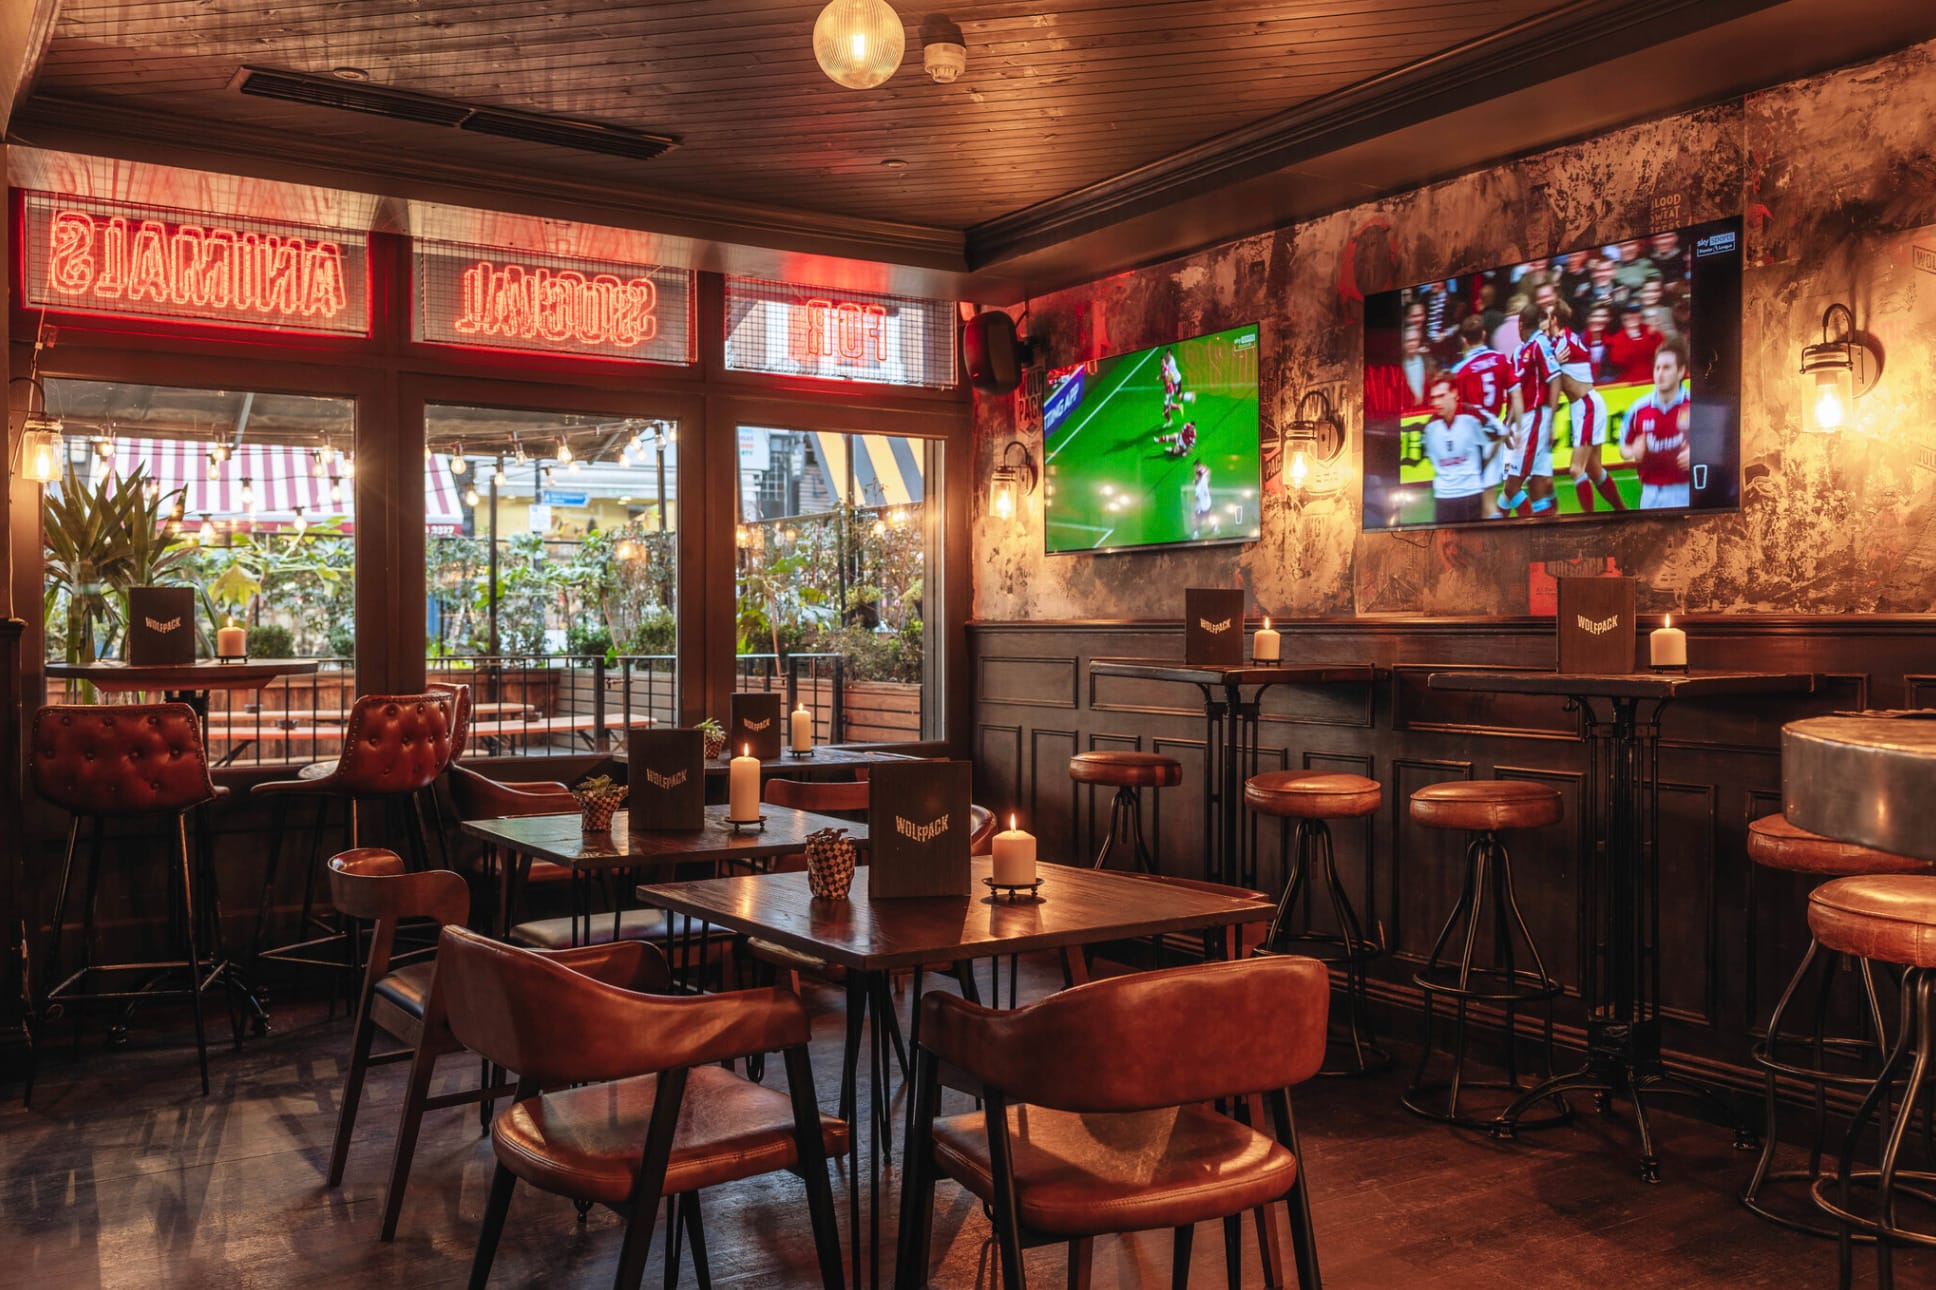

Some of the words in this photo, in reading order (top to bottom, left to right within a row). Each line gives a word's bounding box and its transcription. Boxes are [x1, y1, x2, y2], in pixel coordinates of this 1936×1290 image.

[1651, 194, 1681, 208] LOOD
[1481, 371, 1496, 407] 5
[1265, 454, 1281, 480] PAC
[145, 616, 181, 634] WOLFPACK
[1200, 617, 1231, 635] WOLFPACK
[1577, 614, 1618, 635] WOLFPACK
[646, 768, 687, 790] WOLFPACK
[895, 813, 949, 843] WOLFPACK
